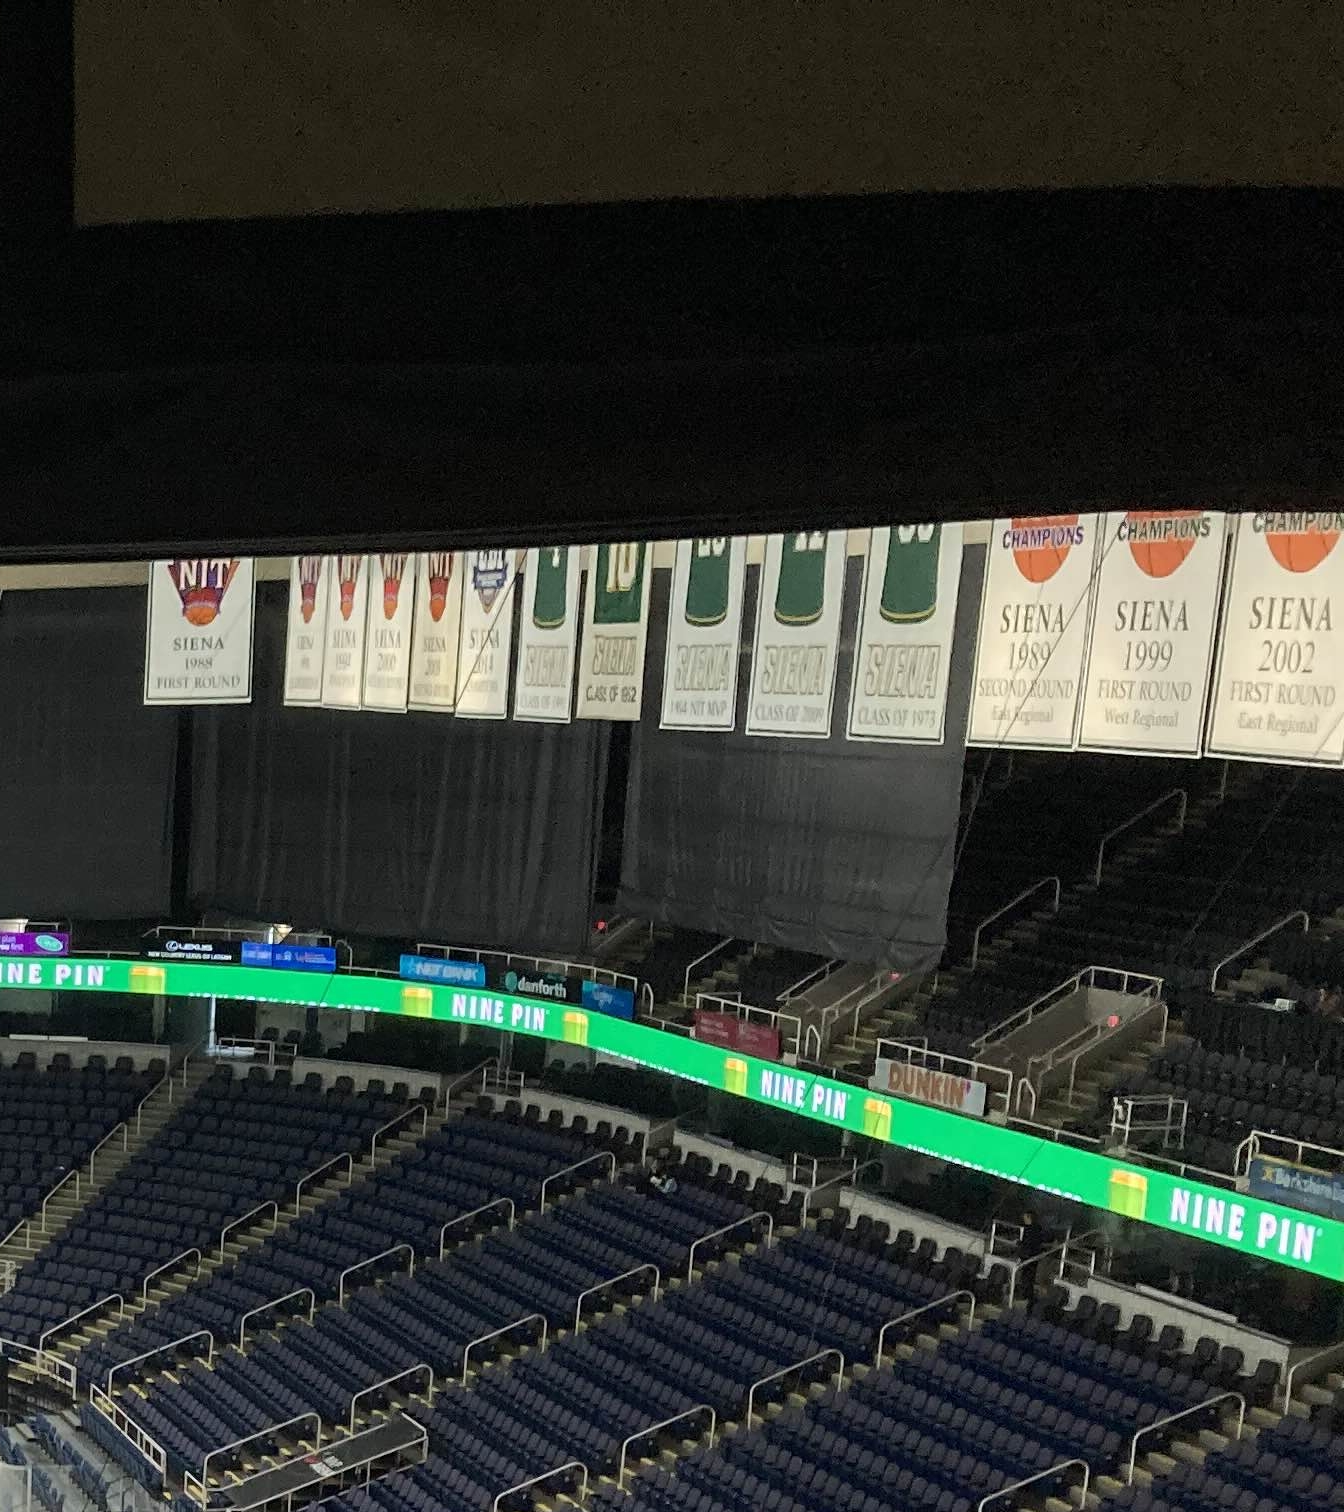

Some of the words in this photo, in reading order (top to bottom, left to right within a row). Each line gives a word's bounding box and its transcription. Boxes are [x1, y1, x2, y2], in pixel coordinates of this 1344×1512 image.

[1118, 517, 1211, 541] CHAMPIONS
[1252, 512, 1344, 533] CHAMPION
[1002, 525, 1084, 550] CHAMPIONS
[180, 560, 231, 590] NIT
[1000, 603, 1066, 634] SIENA
[1114, 600, 1189, 632] SIENA
[1250, 596, 1334, 633] SIENA
[173, 637, 224, 651] SIENA
[1008, 641, 1052, 672] 1989
[1123, 640, 1173, 672] 1999
[1257, 640, 1316, 674] 2002
[157, 676, 189, 689] FIRST
[194, 676, 241, 689] ROUND
[761, 645, 827, 696] SIENA
[864, 644, 941, 699] SIENA
[979, 679, 1024, 699] SECOND
[1030, 679, 1074, 699] ROUND
[1098, 679, 1137, 700] FIRST
[1140, 679, 1193, 702] ROUND
[1230, 680, 1273, 703] FIRST
[1276, 683, 1335, 706] ROUND
[755, 703, 784, 721] CLASS
[858, 708, 891, 726] CLASS
[892, 709, 907, 727] OF
[912, 709, 936, 728] 1973
[1104, 708, 1129, 724] West
[1132, 710, 1179, 729] Regional
[1238, 712, 1263, 730] East
[1267, 715, 1318, 737] Regional
[55, 964, 104, 986] PIN
[517, 976, 567, 998] danforth
[452, 993, 504, 1021] NINE
[512, 1003, 546, 1032] PIN
[761, 1069, 806, 1108] NINE
[812, 1083, 847, 1120] PIN
[888, 1063, 971, 1107] DUNKIN'
[1170, 1187, 1245, 1242] NINE
[1257, 1211, 1316, 1263] PIN
